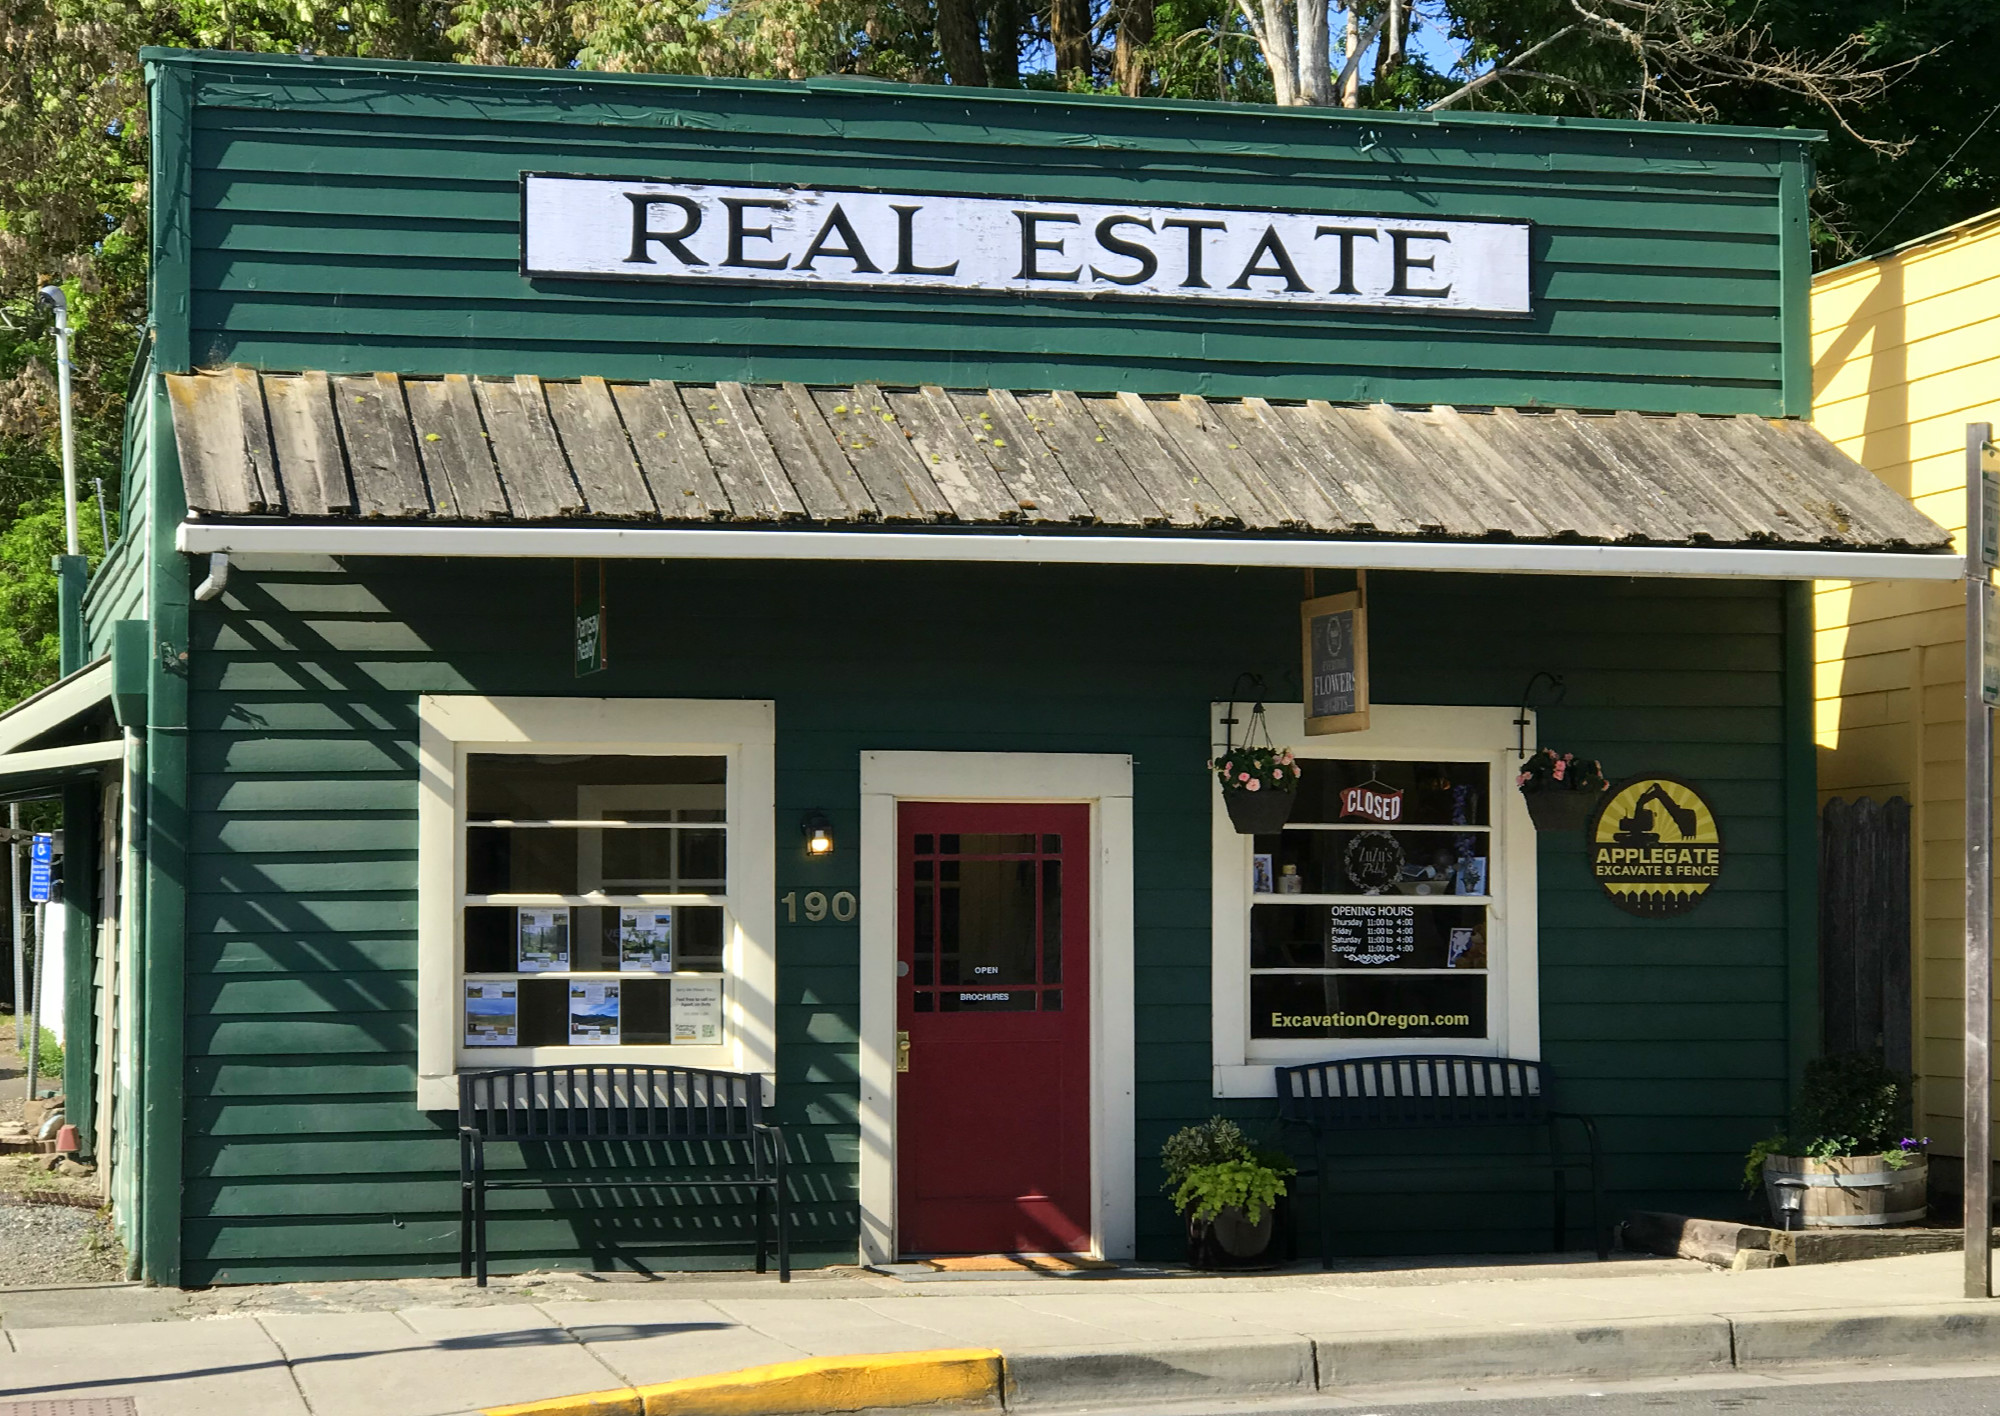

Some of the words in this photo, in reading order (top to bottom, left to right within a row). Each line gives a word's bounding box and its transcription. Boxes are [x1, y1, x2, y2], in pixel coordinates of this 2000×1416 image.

[622, 192, 960, 277] REAL
[1011, 210, 1453, 299] ESTATE
[1347, 789, 1400, 821] CLOSED
[1596, 848, 1720, 864] APPLEGATE
[1596, 865, 1662, 876] EXCAVATE
[1664, 865, 1673, 876] &
[1676, 865, 1719, 876] FENCE
[781, 891, 857, 923] 190
[1331, 906, 1376, 916] OPENING
[1378, 906, 1414, 916] HOURS
[1331, 918, 1363, 927] Thursday
[1367, 918, 1385, 926] 11:00
[1386, 918, 1394, 926] to
[1331, 927, 1352, 936] Friday
[1367, 927, 1385, 935] 11:00
[1386, 927, 1394, 935] to
[1331, 936, 1362, 945] Saturday
[1368, 936, 1385, 944] 11:00
[1386, 936, 1394, 944] to
[1331, 945, 1358, 953] Sunday
[974, 966, 999, 974] OPEN
[960, 993, 1009, 1001] BROCHURES
[1271, 1010, 1470, 1029] ExcavationOregon.com
